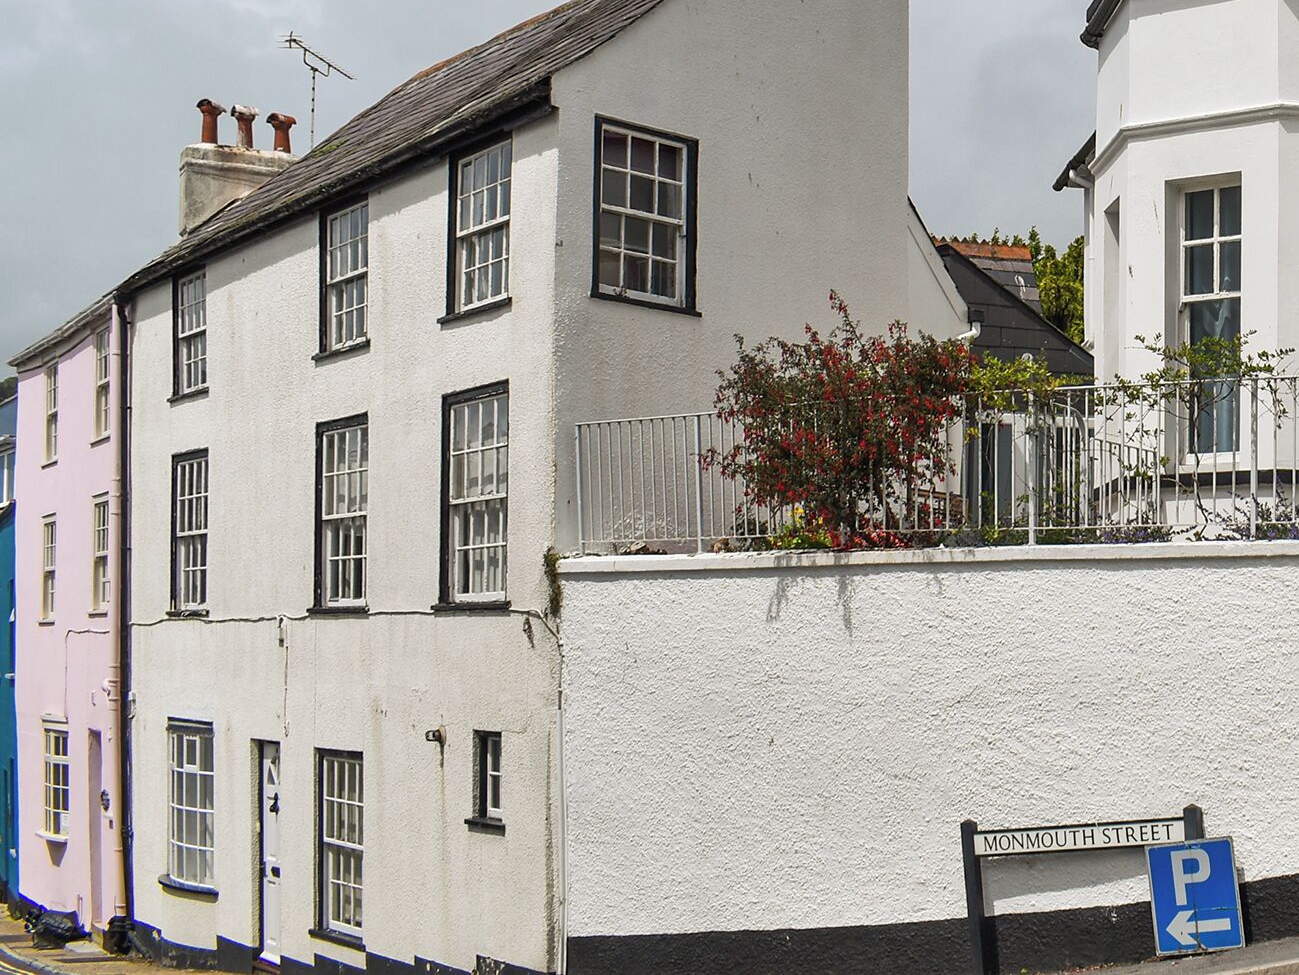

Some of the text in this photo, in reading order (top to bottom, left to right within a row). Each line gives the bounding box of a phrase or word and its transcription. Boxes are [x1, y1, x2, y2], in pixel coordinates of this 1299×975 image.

[983, 823, 1174, 853] MONMOUTH STREET
[1170, 848, 1212, 907] P
